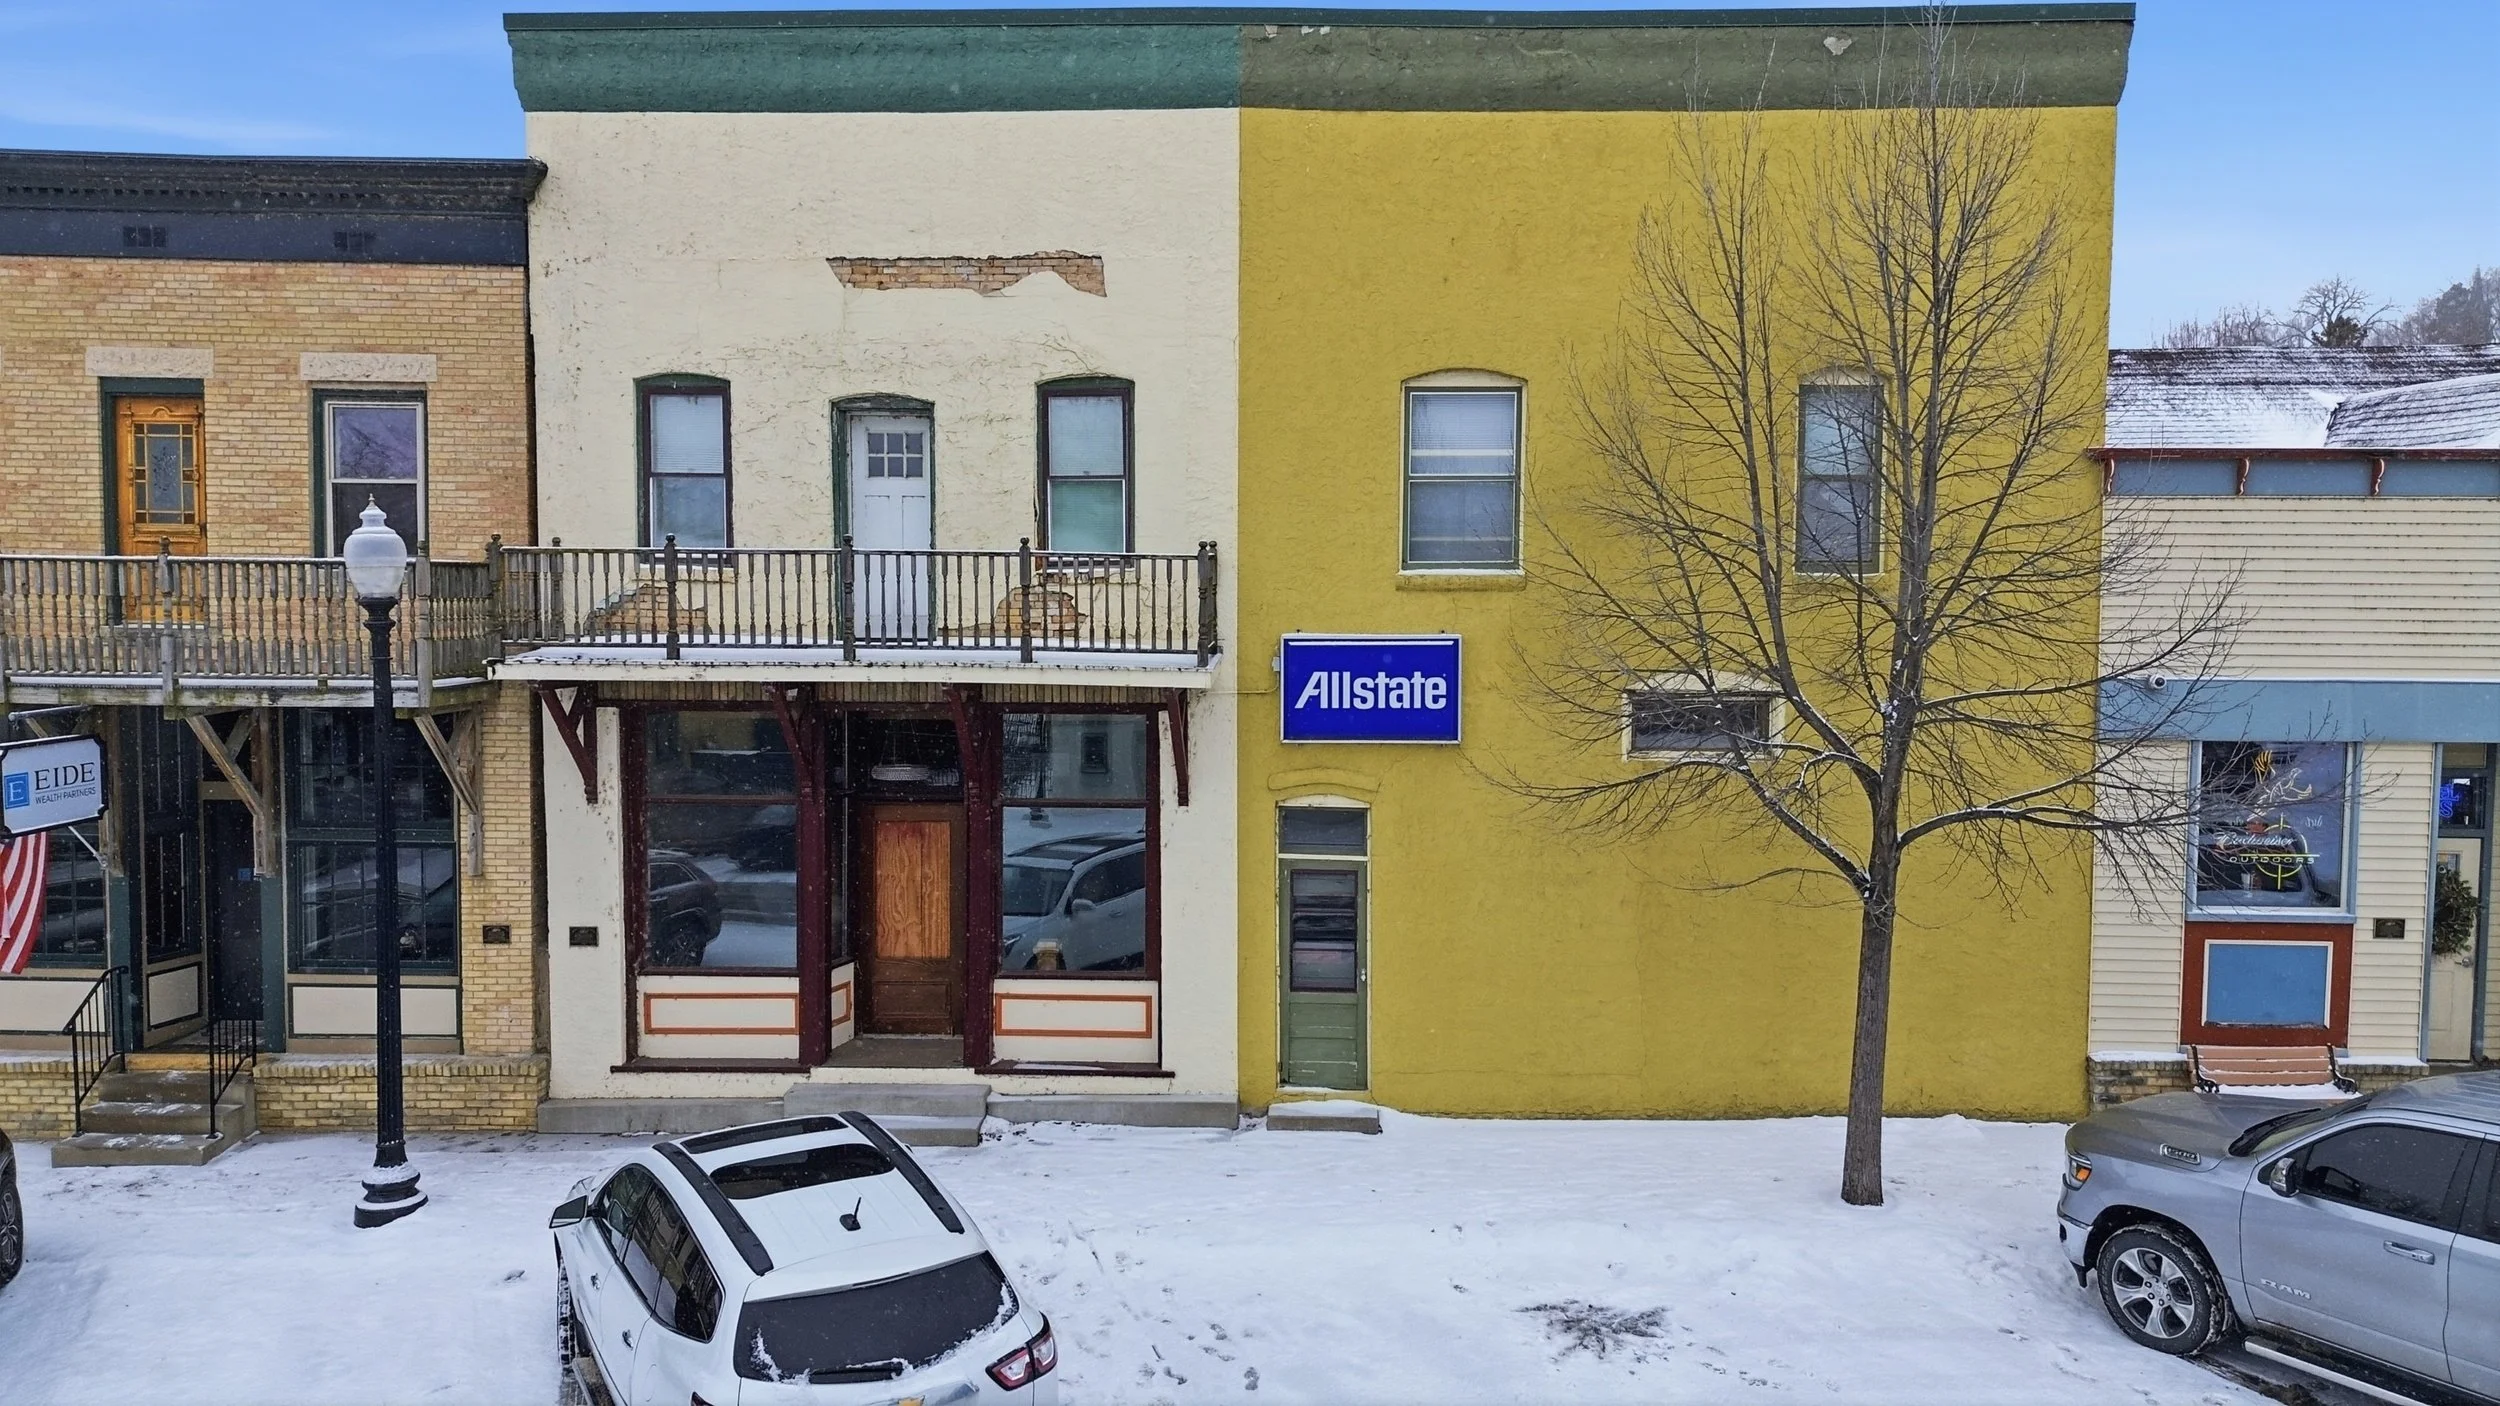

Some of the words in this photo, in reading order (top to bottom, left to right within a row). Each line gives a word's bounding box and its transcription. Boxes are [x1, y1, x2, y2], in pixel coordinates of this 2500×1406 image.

[1295, 671, 1447, 710] Allstate
[33, 762, 96, 791] EIDE
[8, 780, 25, 802] E
[35, 793, 62, 804] WEALTH
[63, 786, 96, 799] PARTNERS
[2229, 856, 2315, 864] OUTDOORS
[2260, 1278, 2310, 1300] RAM
